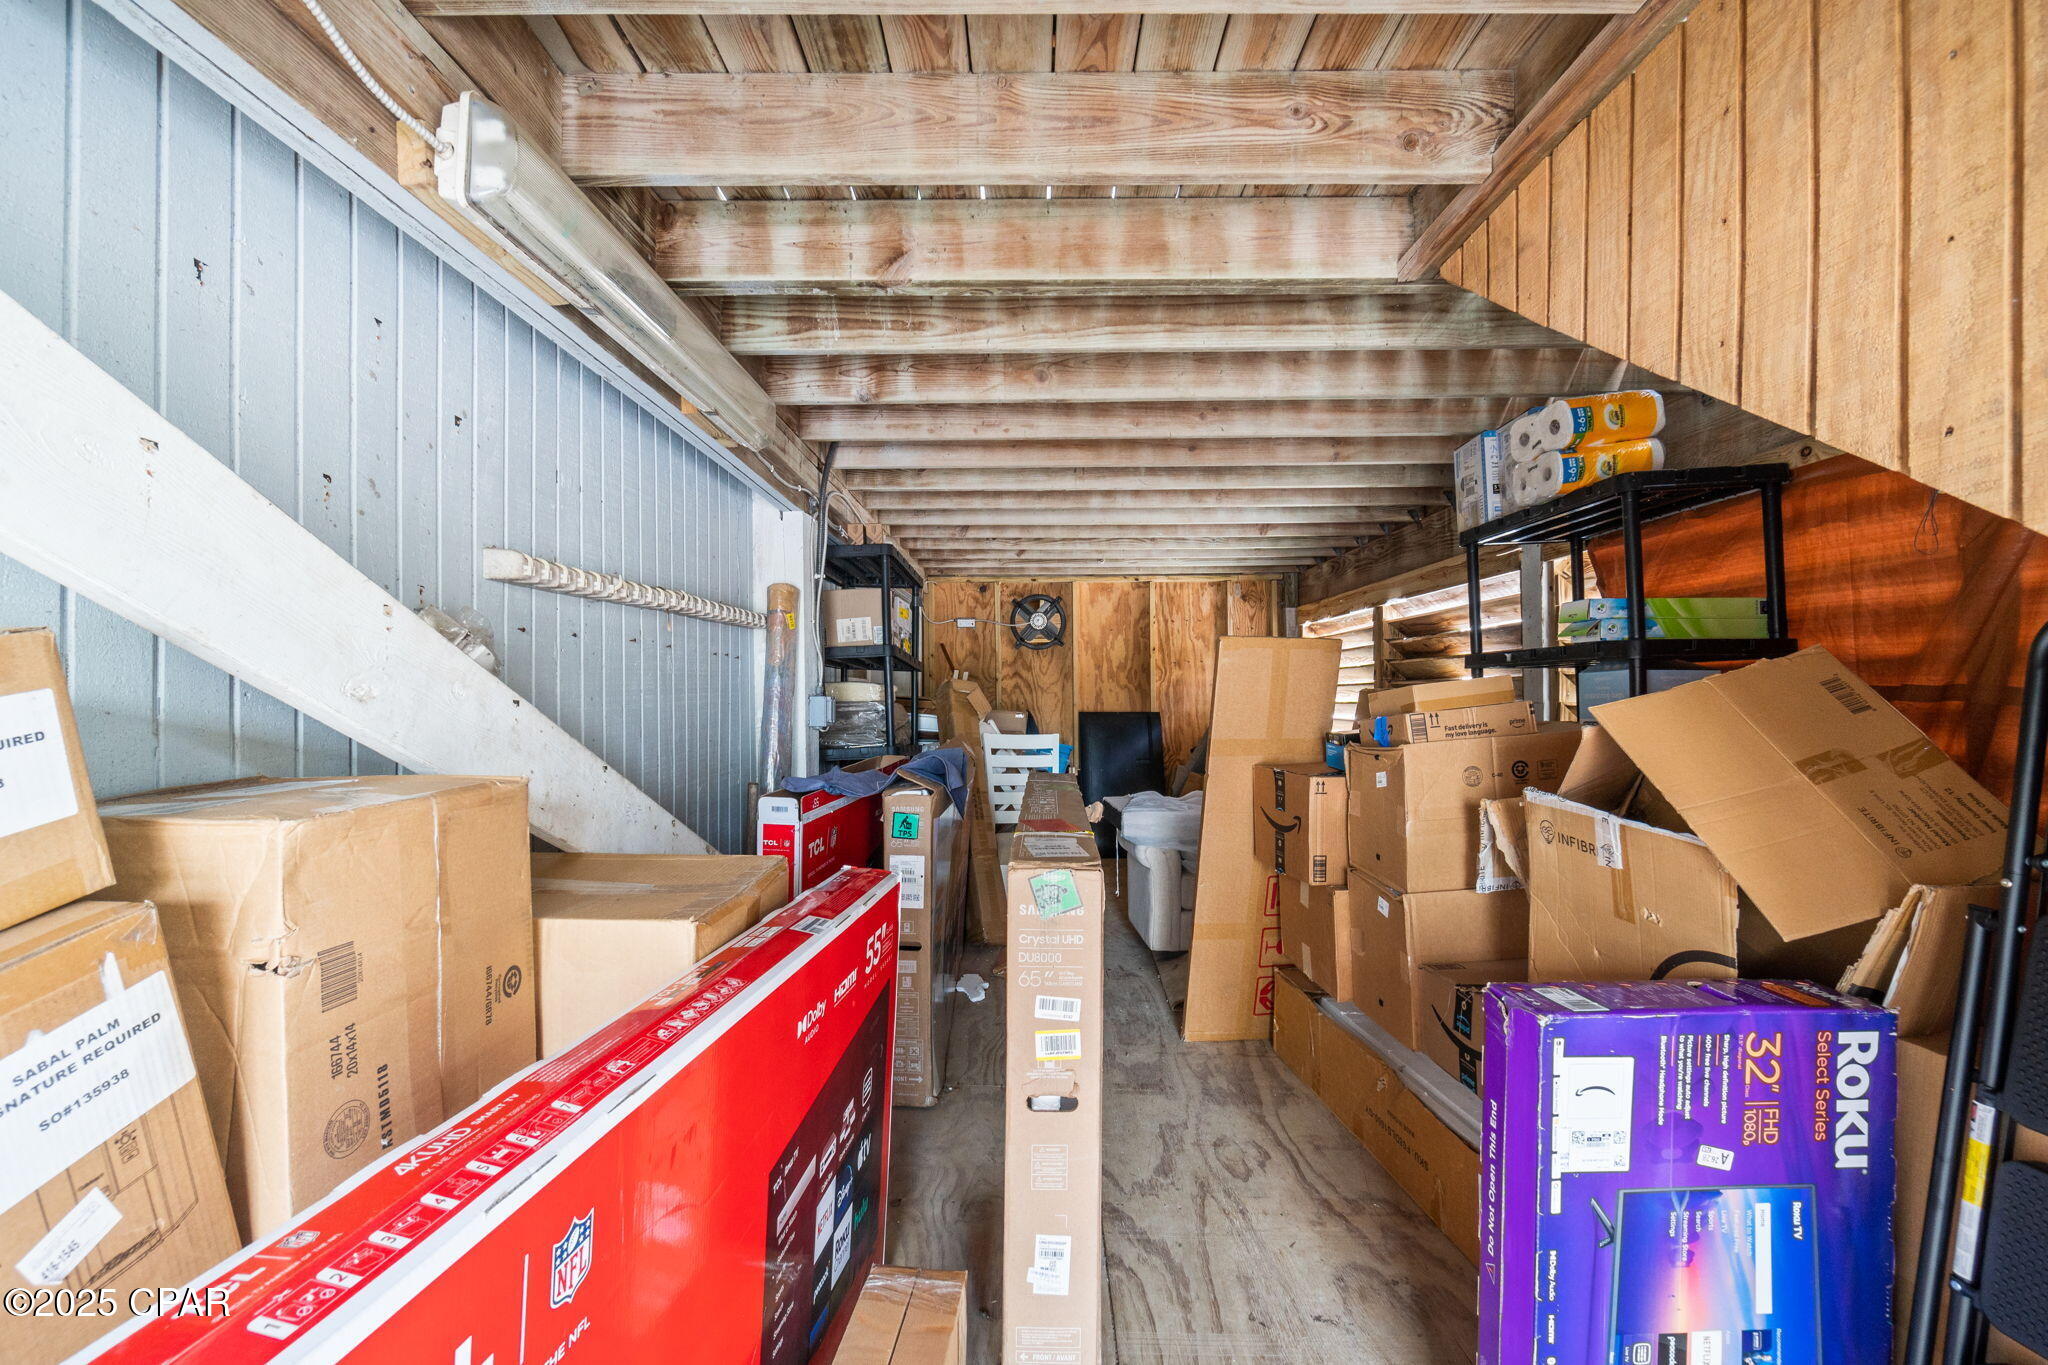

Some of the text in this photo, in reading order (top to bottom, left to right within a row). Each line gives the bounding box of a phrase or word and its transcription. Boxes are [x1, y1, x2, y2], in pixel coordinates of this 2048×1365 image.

[1458, 722, 1481, 731] delivery
[1468, 728, 1497, 738] language.
[1857, 806, 1900, 846] INFIBRITE
[808, 837, 824, 858] TCL
[1558, 832, 1596, 857] INFIBR
[1019, 904, 1084, 916] SANG
[1019, 934, 1084, 946] Crystal UHD
[1018, 952, 1062, 963] DU8000
[808, 999, 826, 1028] Dolby
[82, 1012, 162, 1066] REQUIRED
[804, 1024, 820, 1045] AUDIO
[1722, 1034, 1730, 1054] Sharp,
[12, 1018, 121, 1087] SABAL PALM
[329, 1035, 343, 1080] 166744
[344, 1022, 358, 1078] 20x14x14
[1722, 1055, 1730, 1070] high
[38, 1068, 130, 1132] SO#135938
[1814, 1032, 1832, 1142] Select Series
[470, 1103, 506, 1126] SMART
[504, 1093, 520, 1102] TV
[1742, 1108, 1756, 1146] 1080p
[1764, 1108, 1779, 1144] FHD
[432, 1156, 450, 1168] THE
[449, 1122, 494, 1156] RESOLUTION
[1488, 1168, 1498, 1201] Open
[817, 1202, 833, 1236] NETFLIX
[1668, 1211, 1677, 1238] Settings
[1681, 1211, 1690, 1242] Streaming
[1707, 1210, 1715, 1231] Sports
[1721, 1224, 1727, 1234] TV
[1794, 1224, 1804, 1240] TV
[1488, 1236, 1494, 1256] Do
[557, 1244, 586, 1298] NFL
[1548, 1280, 1557, 1300] Audio
[568, 1316, 590, 1348] NFL
